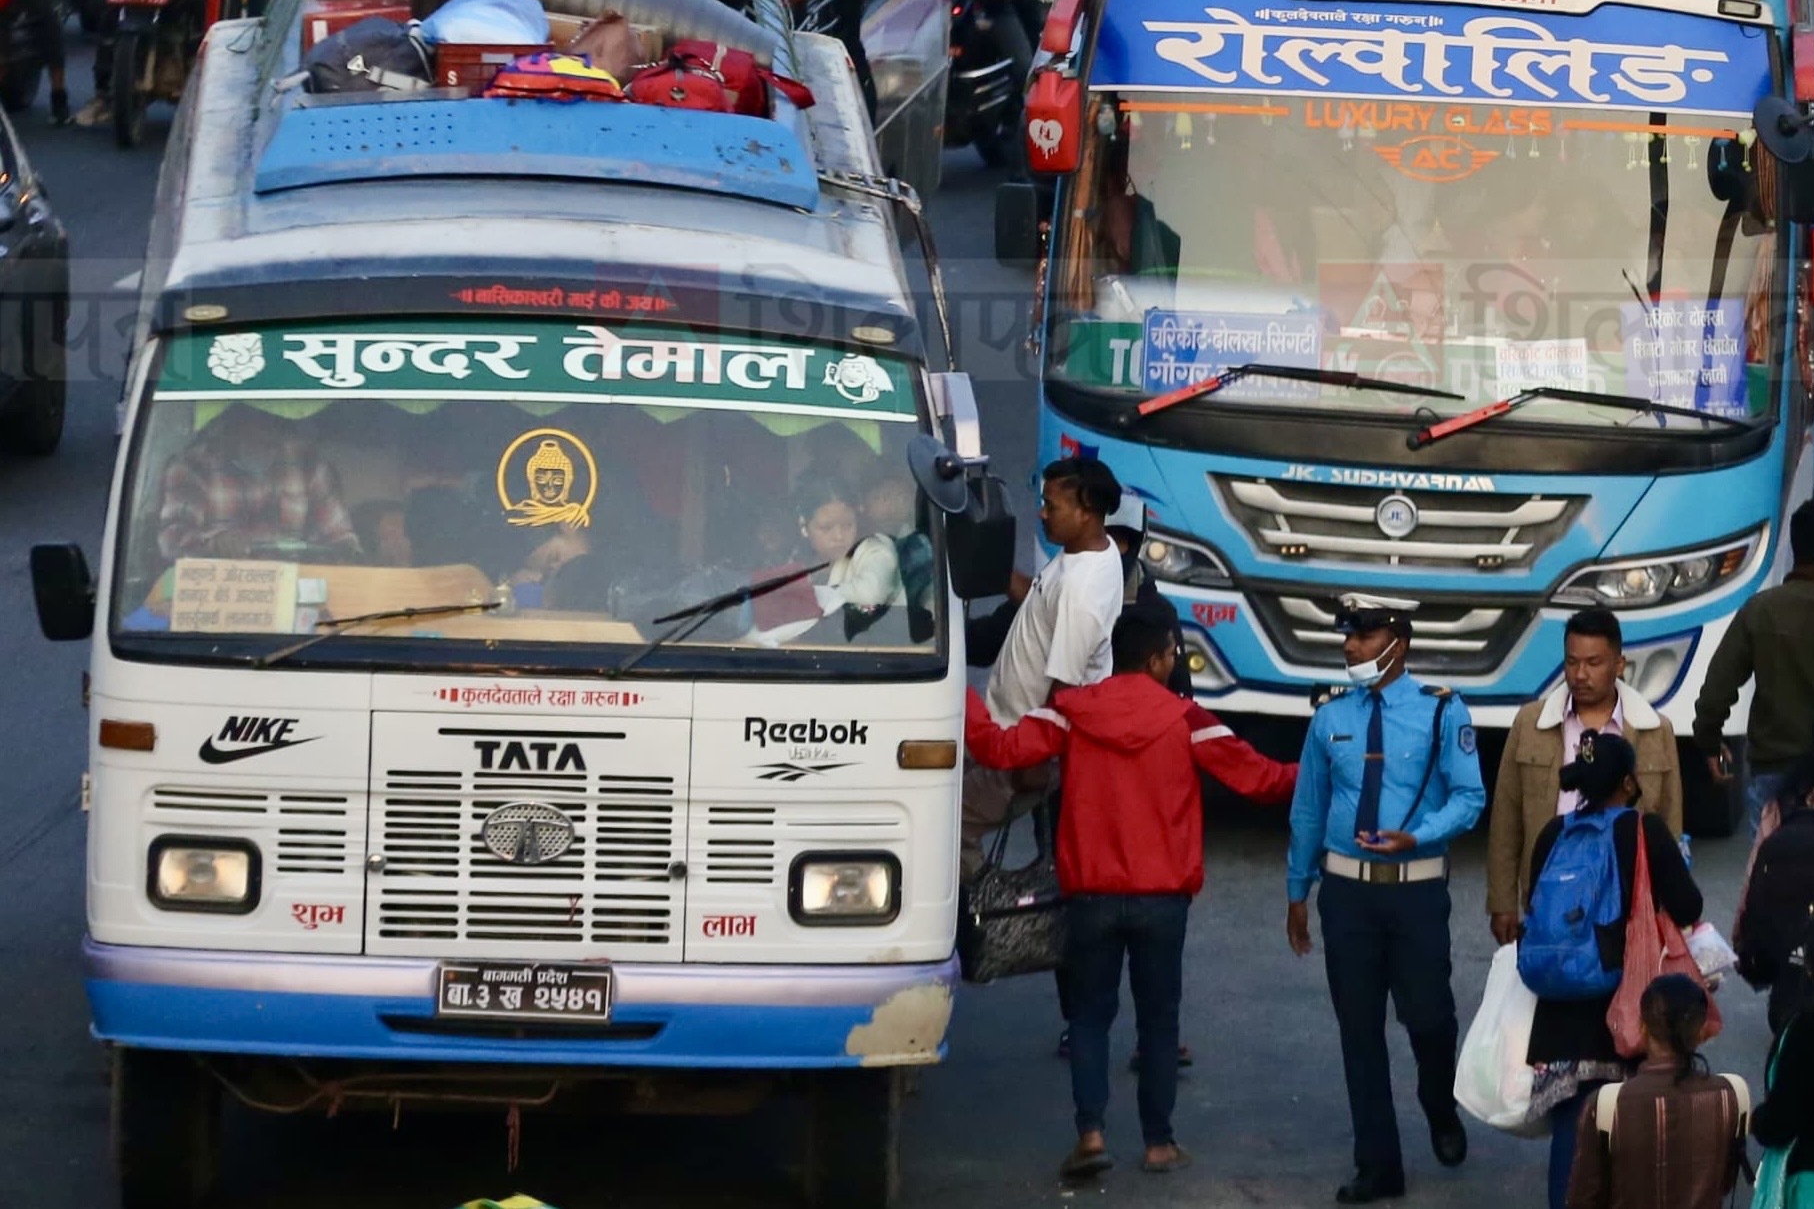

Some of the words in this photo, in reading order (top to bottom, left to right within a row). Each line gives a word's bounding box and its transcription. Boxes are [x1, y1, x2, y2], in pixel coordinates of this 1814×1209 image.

[1304, 99, 1436, 132] LUXURY
[1443, 106, 1553, 136] CLASS
[1410, 147, 1462, 170] AC
[281, 331, 538, 389] सुन्दर
[562, 325, 815, 391] तेमाल
[461, 684, 541, 709] कुलदेवताले
[548, 690, 576, 707] रक्षा
[217, 716, 300, 744] NIKE
[744, 716, 869, 748] Reebok
[474, 741, 587, 772] TATA
[291, 898, 346, 931] शुभ
[701, 909, 757, 941] लाभ
[533, 986, 602, 1012] २५४१
